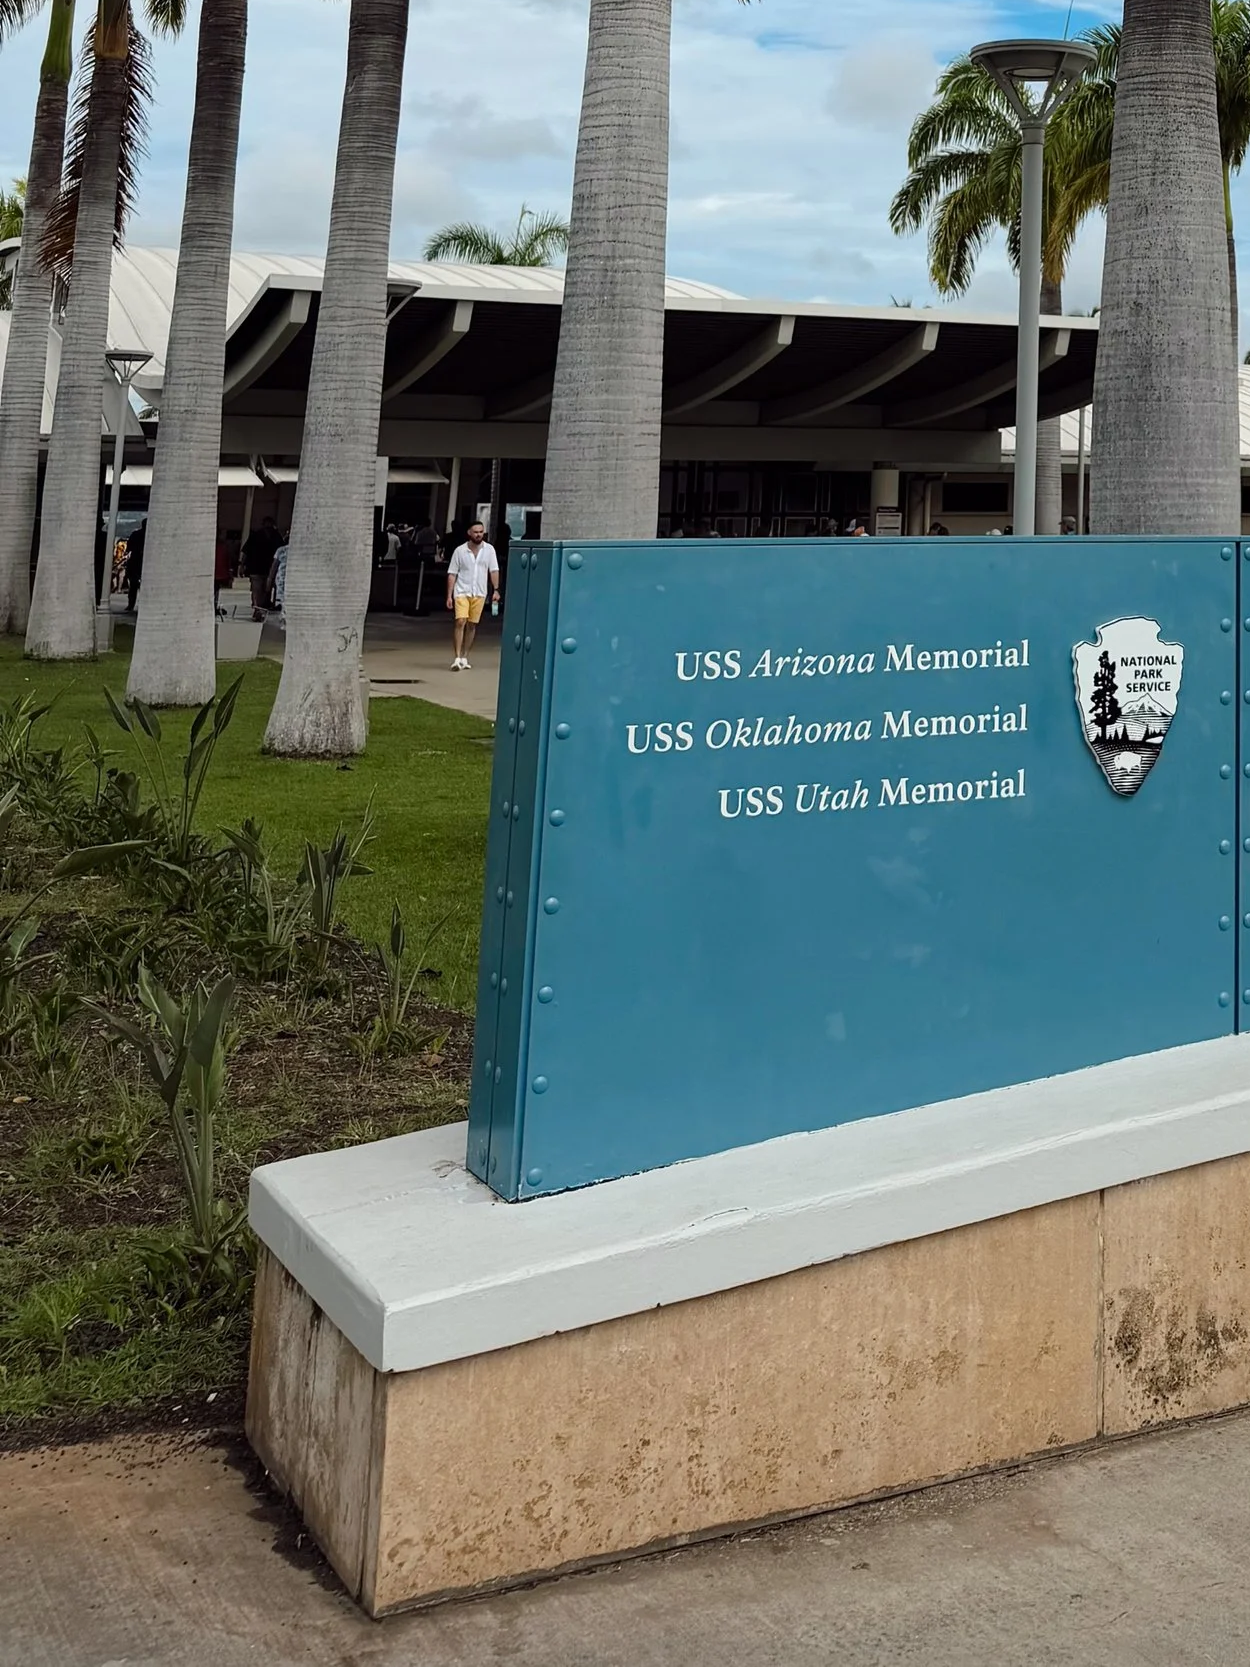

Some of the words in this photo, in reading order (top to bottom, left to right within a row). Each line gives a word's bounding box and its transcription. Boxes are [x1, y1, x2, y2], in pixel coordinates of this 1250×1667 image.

[675, 650, 741, 681] USS
[748, 647, 875, 679] Arizona
[883, 639, 1030, 672] Memorial
[1120, 655, 1177, 667] NATIONAL
[1126, 681, 1171, 693] SERVICE
[1134, 668, 1163, 680] PARK
[625, 721, 694, 754] USS
[705, 715, 872, 749] Oklahoma
[880, 703, 1028, 739] Memorial
[718, 785, 784, 818] USS
[795, 779, 869, 813] Utah
[877, 768, 1026, 807] Memorial
